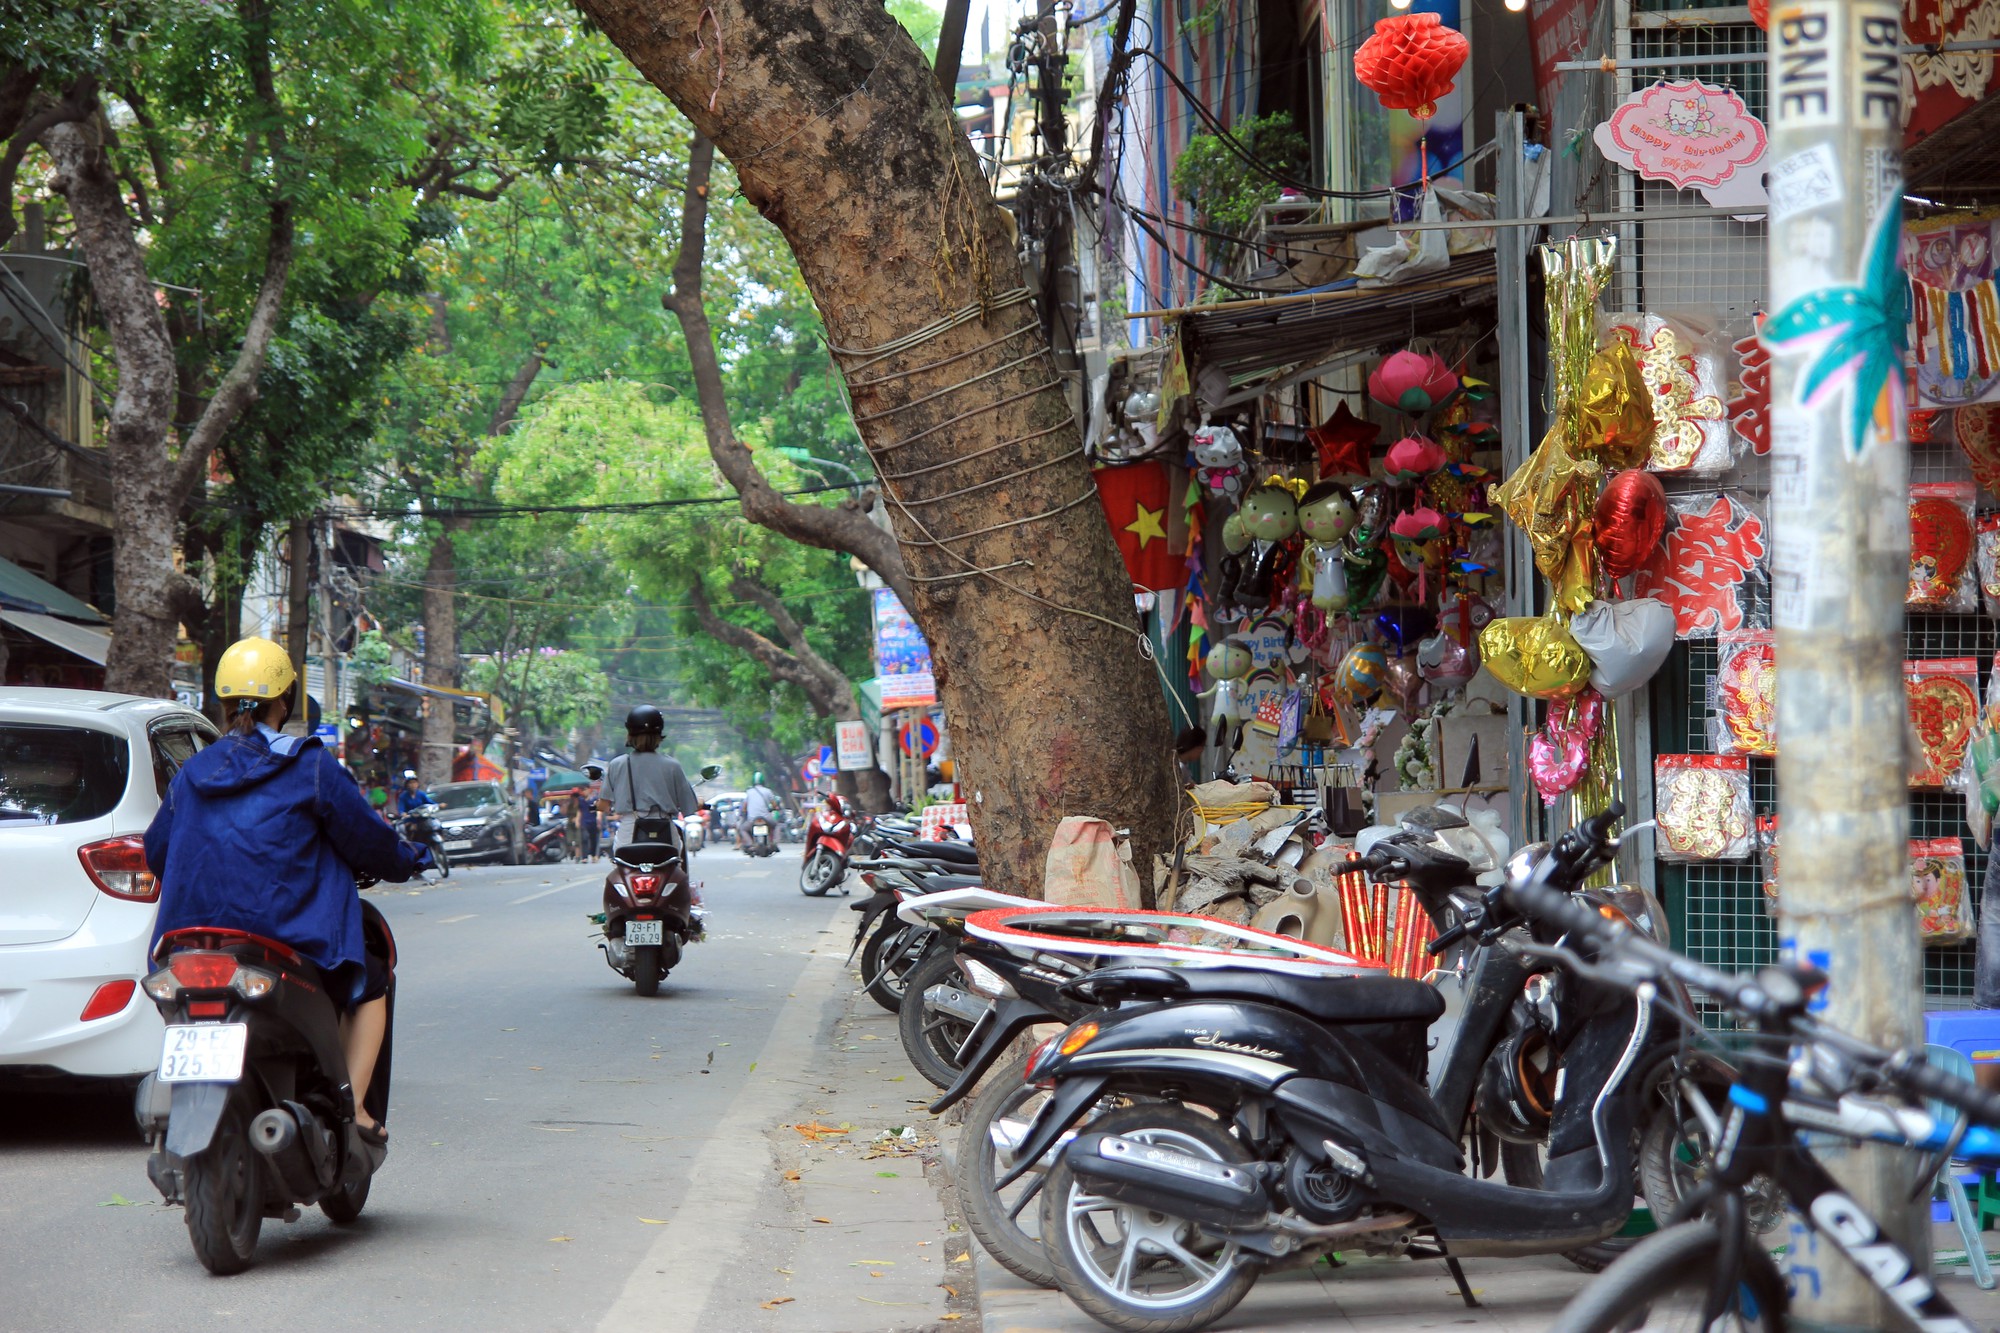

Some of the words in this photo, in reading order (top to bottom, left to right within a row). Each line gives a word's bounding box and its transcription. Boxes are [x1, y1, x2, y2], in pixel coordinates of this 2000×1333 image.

[1779, 13, 1828, 119] BNE
[1862, 16, 1898, 118] BNE
[1629, 123, 1671, 151] Happy
[1683, 130, 1746, 157] Birthday
[628, 933, 660, 944] 486.29
[631, 922, 657, 933] 29-F1
[1193, 1030, 1284, 1059] Classico
